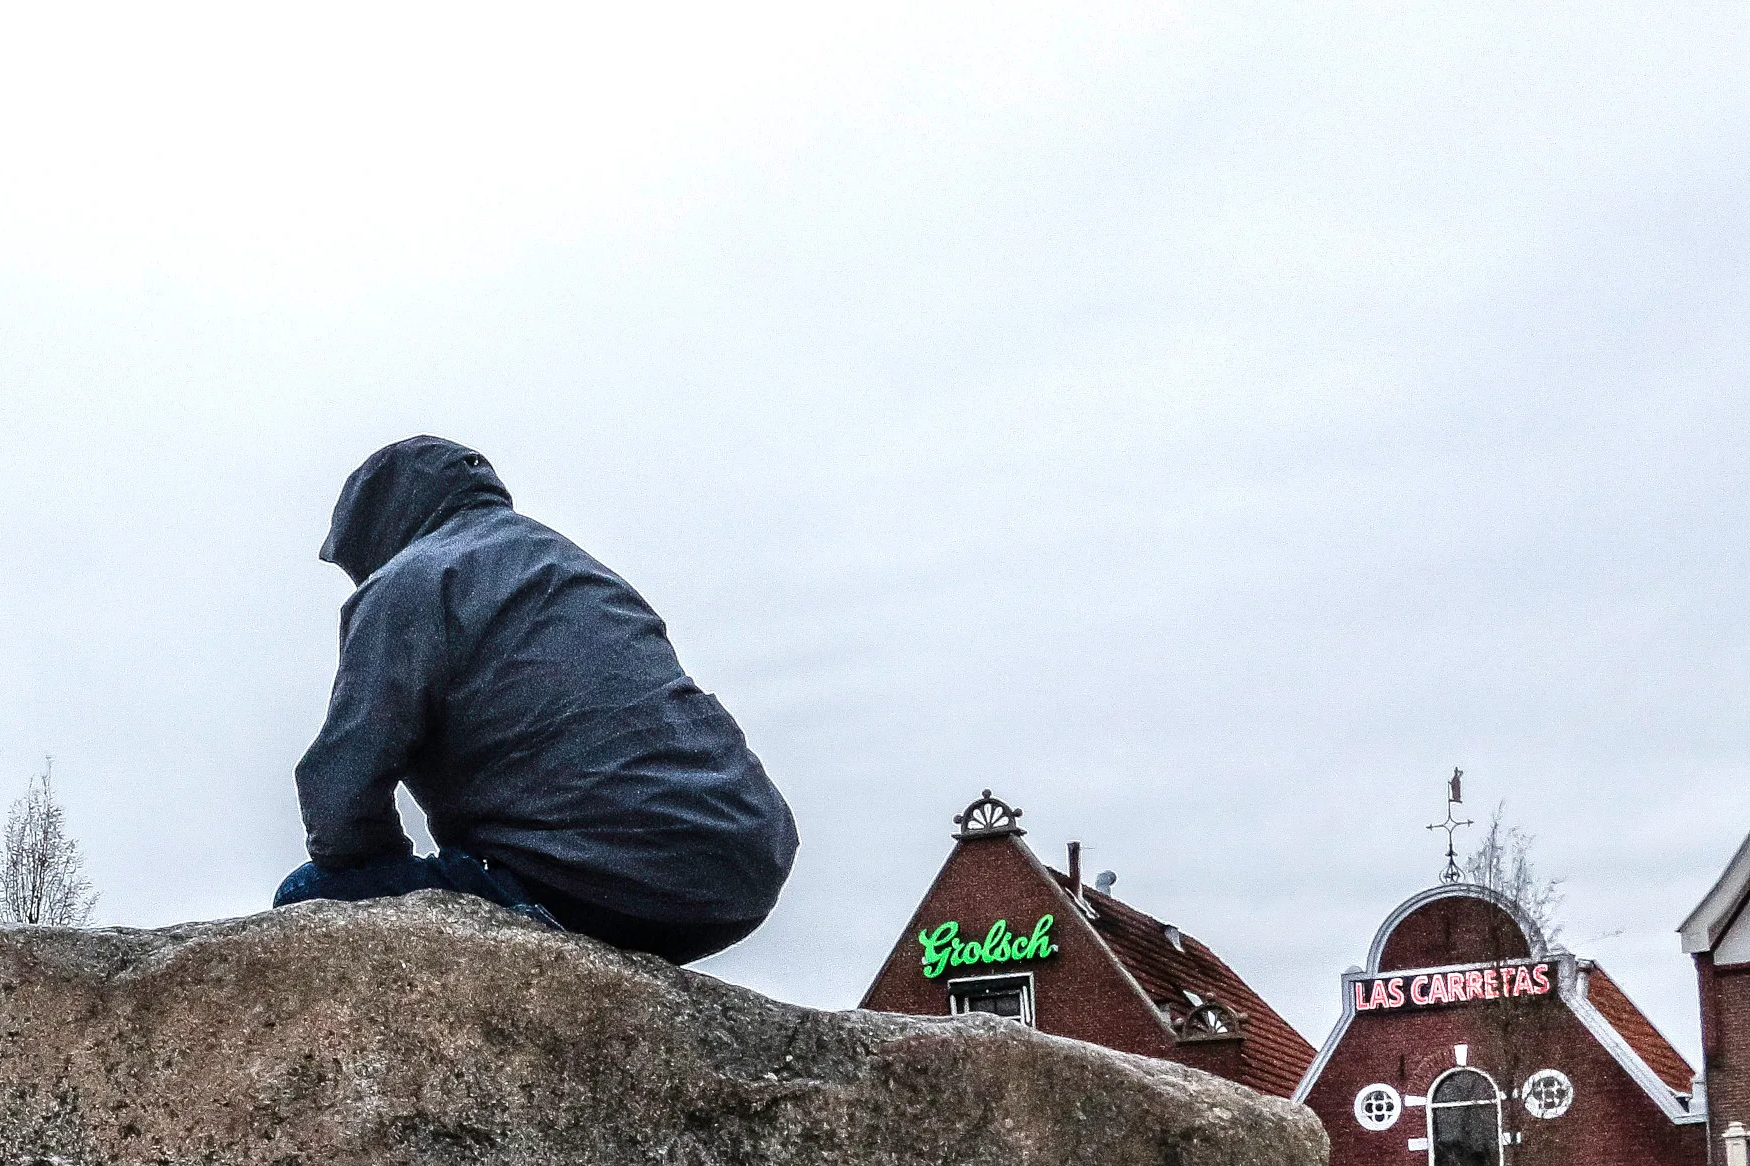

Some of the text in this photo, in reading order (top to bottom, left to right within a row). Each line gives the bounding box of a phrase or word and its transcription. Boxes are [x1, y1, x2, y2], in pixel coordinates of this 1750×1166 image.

[918, 914, 1054, 978] Grolsch
[1355, 964, 1550, 1011] LAS CARRETAS
